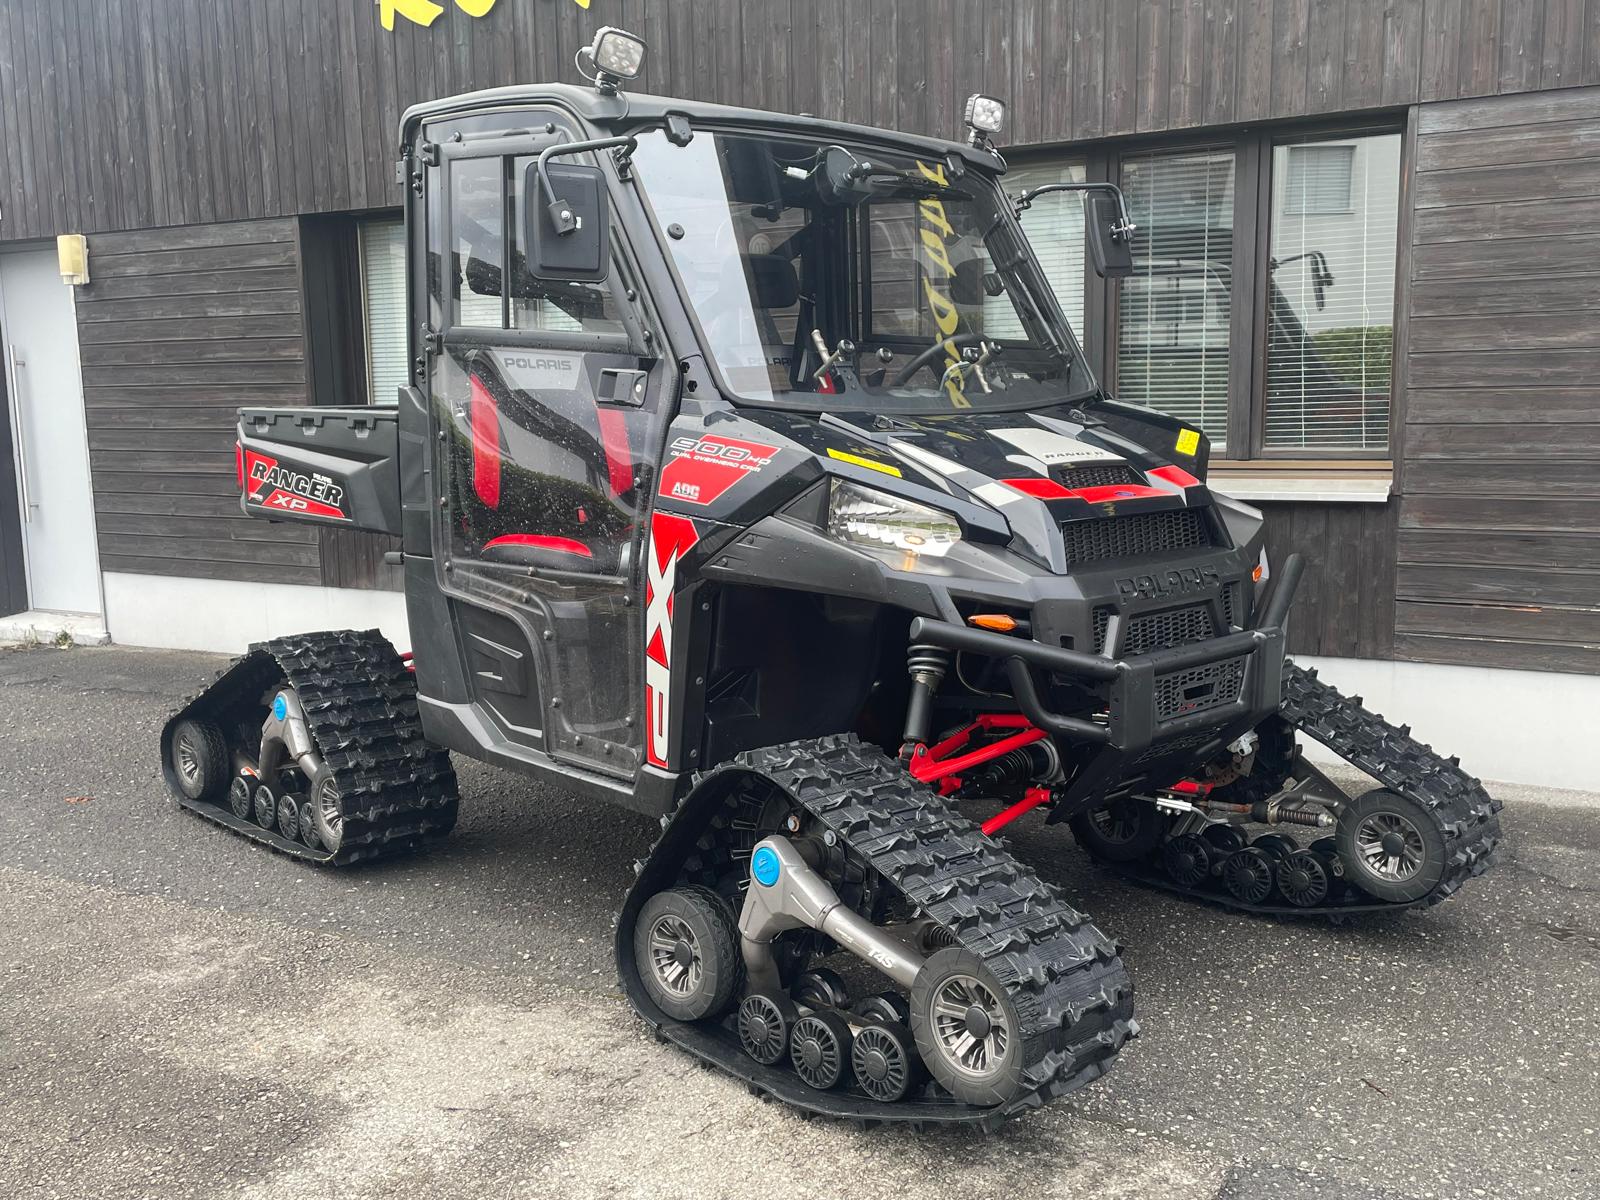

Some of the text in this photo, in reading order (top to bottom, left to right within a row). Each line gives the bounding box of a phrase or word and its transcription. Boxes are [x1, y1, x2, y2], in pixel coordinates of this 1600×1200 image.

[503, 357, 572, 371] POLARIS
[670, 450, 692, 459] DUAL
[251, 460, 344, 507] RANGER
[273, 494, 308, 510] XP
